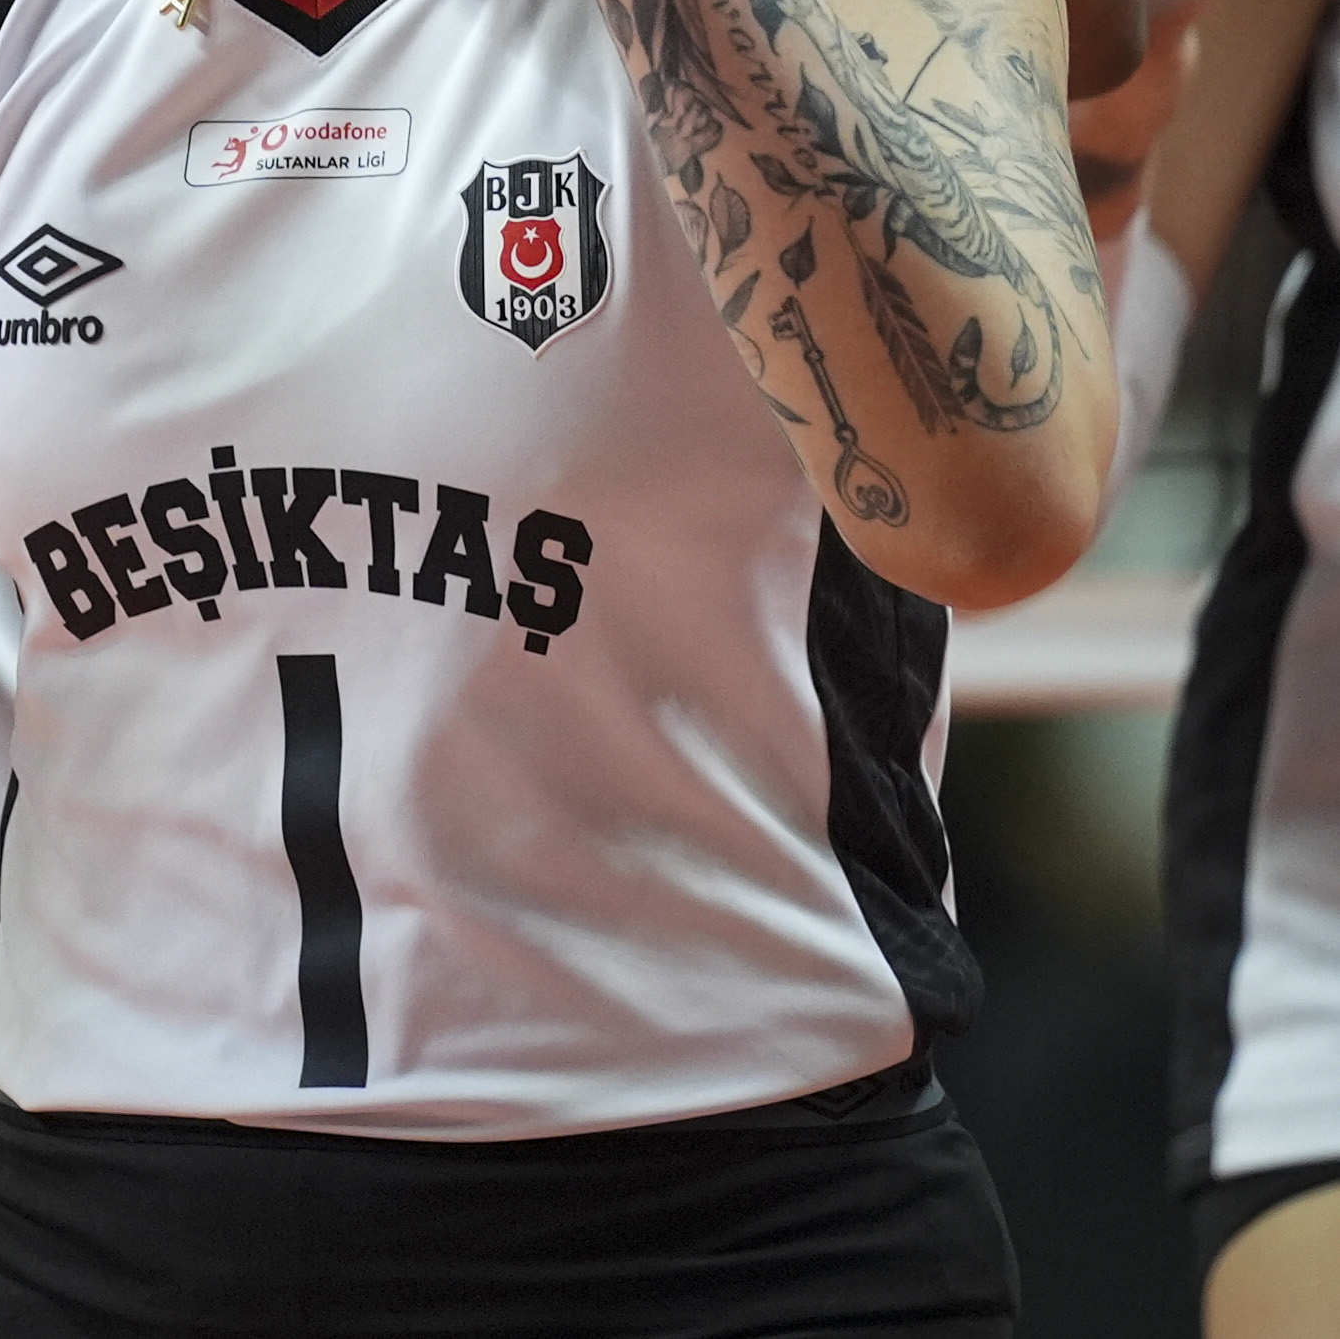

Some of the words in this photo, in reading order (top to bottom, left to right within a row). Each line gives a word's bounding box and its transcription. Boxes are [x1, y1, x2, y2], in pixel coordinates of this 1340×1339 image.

[294, 122, 387, 140] vodafone
[256, 155, 349, 170] SULTANLAR
[486, 172, 577, 211] BJK
[495, 294, 577, 322] 1903
[24, 446, 593, 655] BEŞİKTAŞ
[276, 654, 369, 1089] 1
